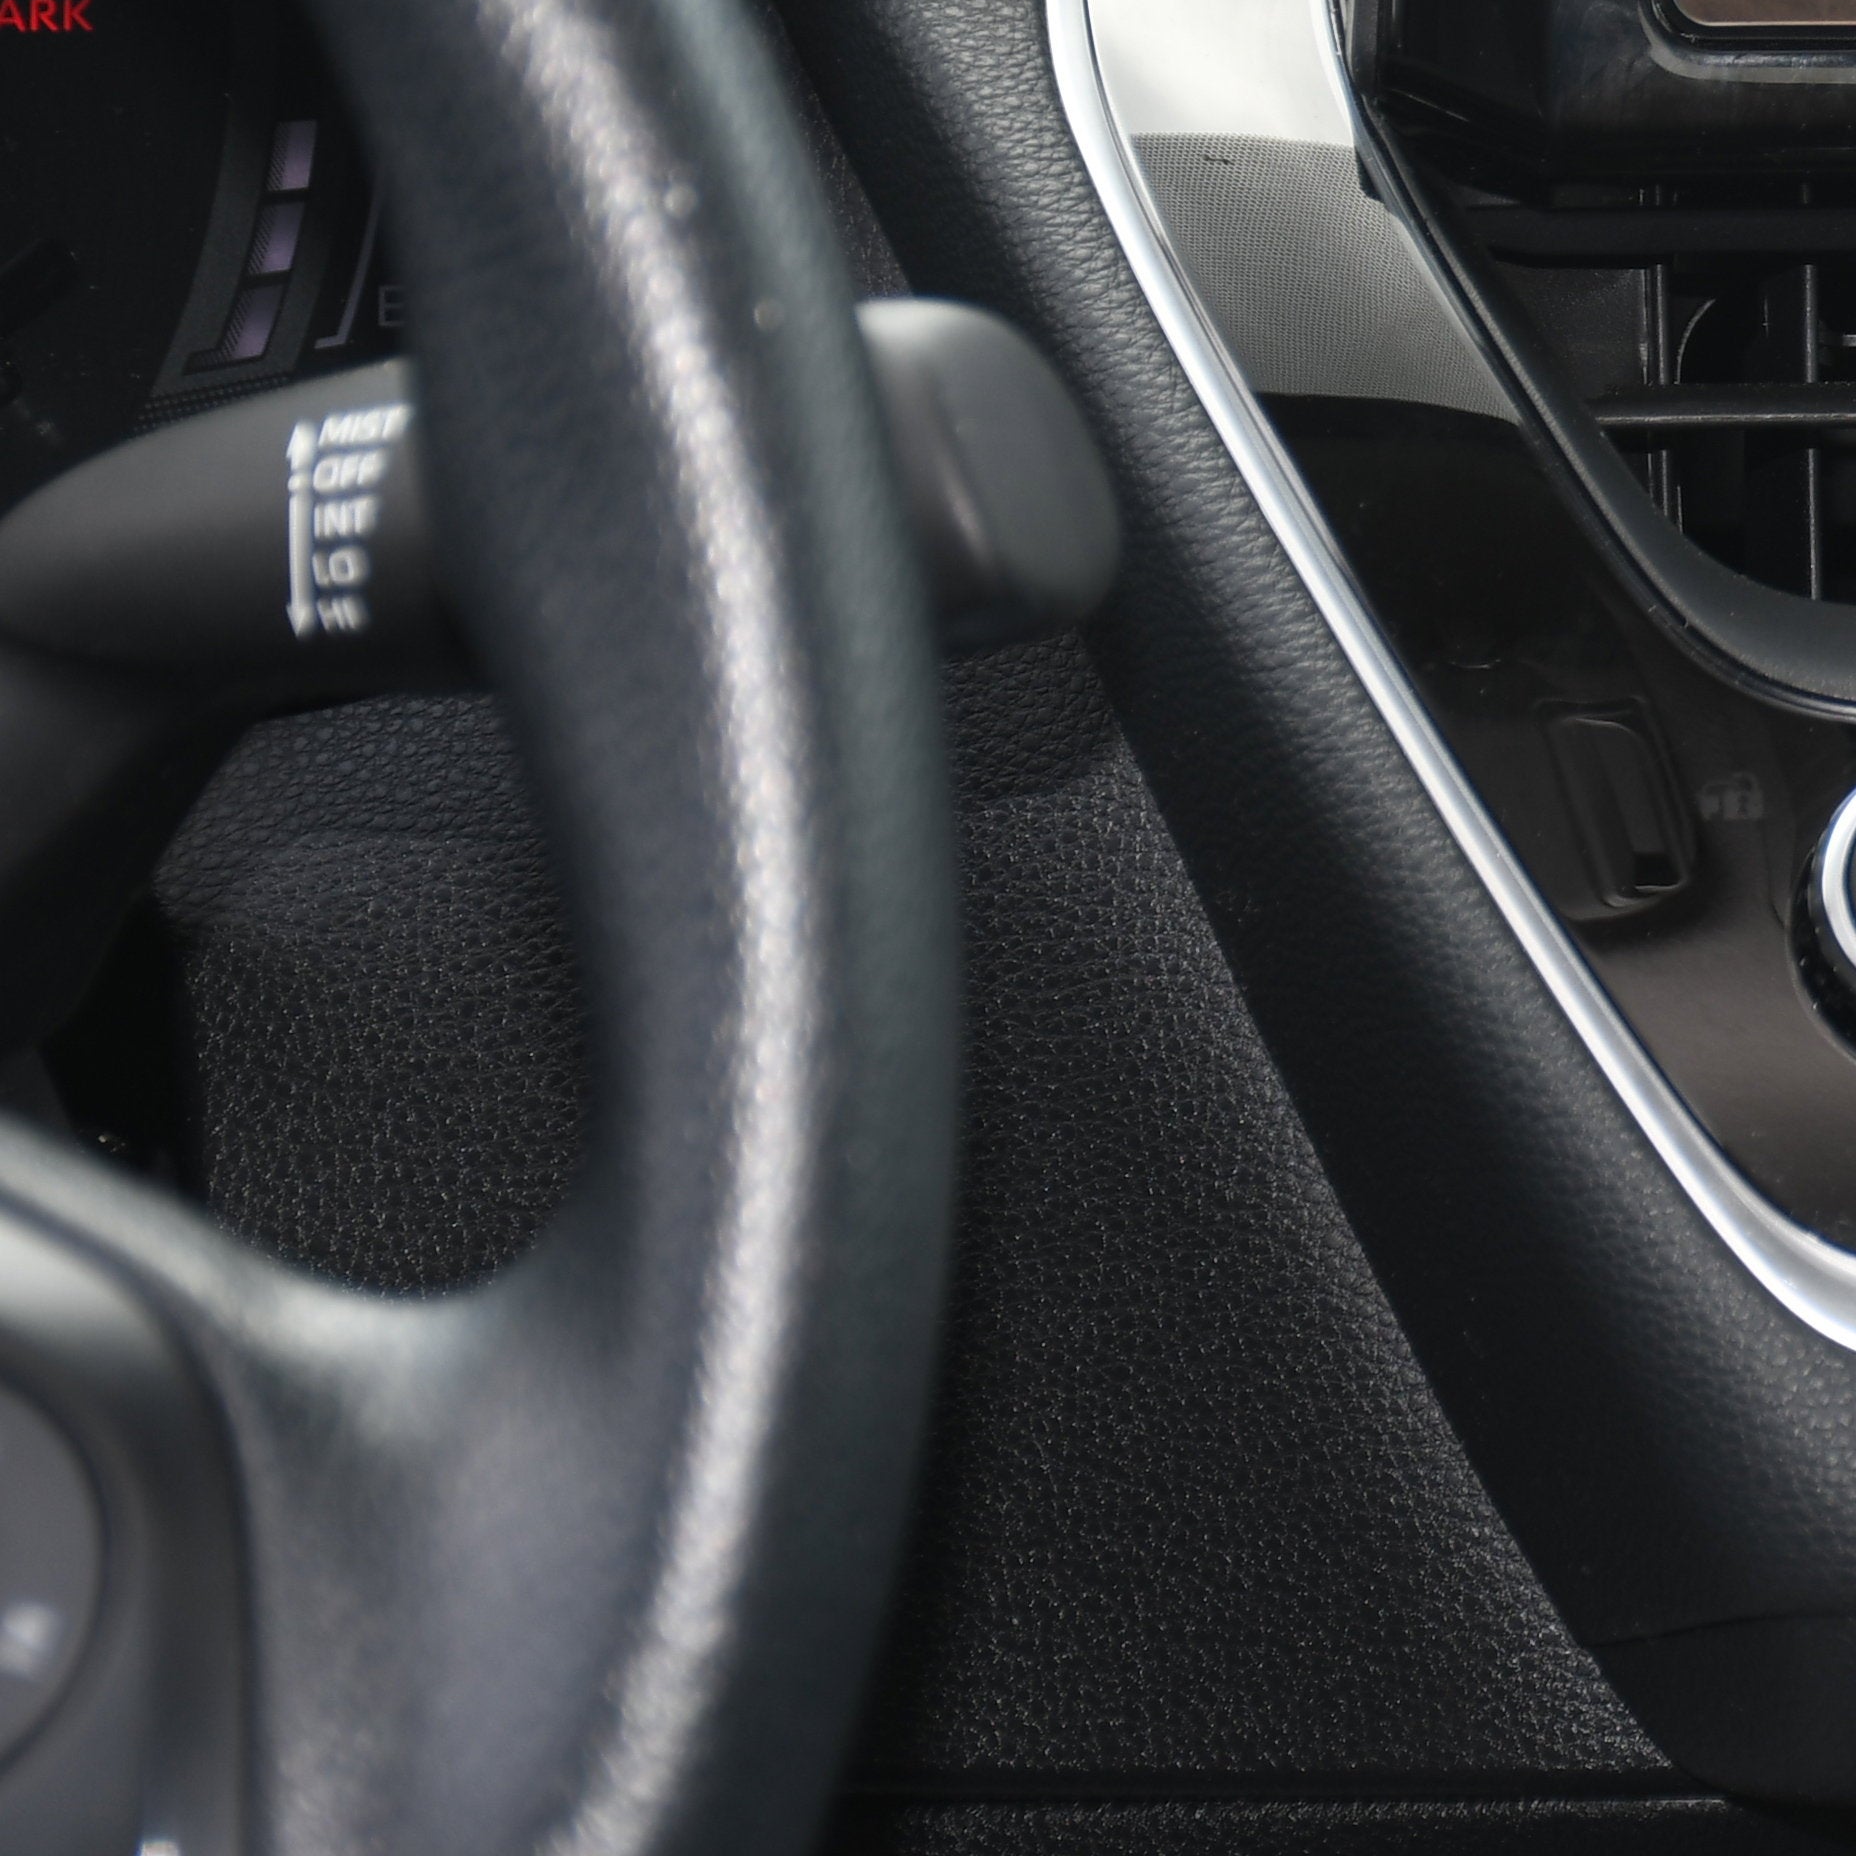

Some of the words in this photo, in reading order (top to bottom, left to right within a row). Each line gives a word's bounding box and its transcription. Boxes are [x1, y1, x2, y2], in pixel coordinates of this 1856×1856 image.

[319, 403, 412, 445] MIST
[313, 451, 386, 493] OFF
[314, 496, 376, 539] INT
[313, 547, 368, 587] LO
